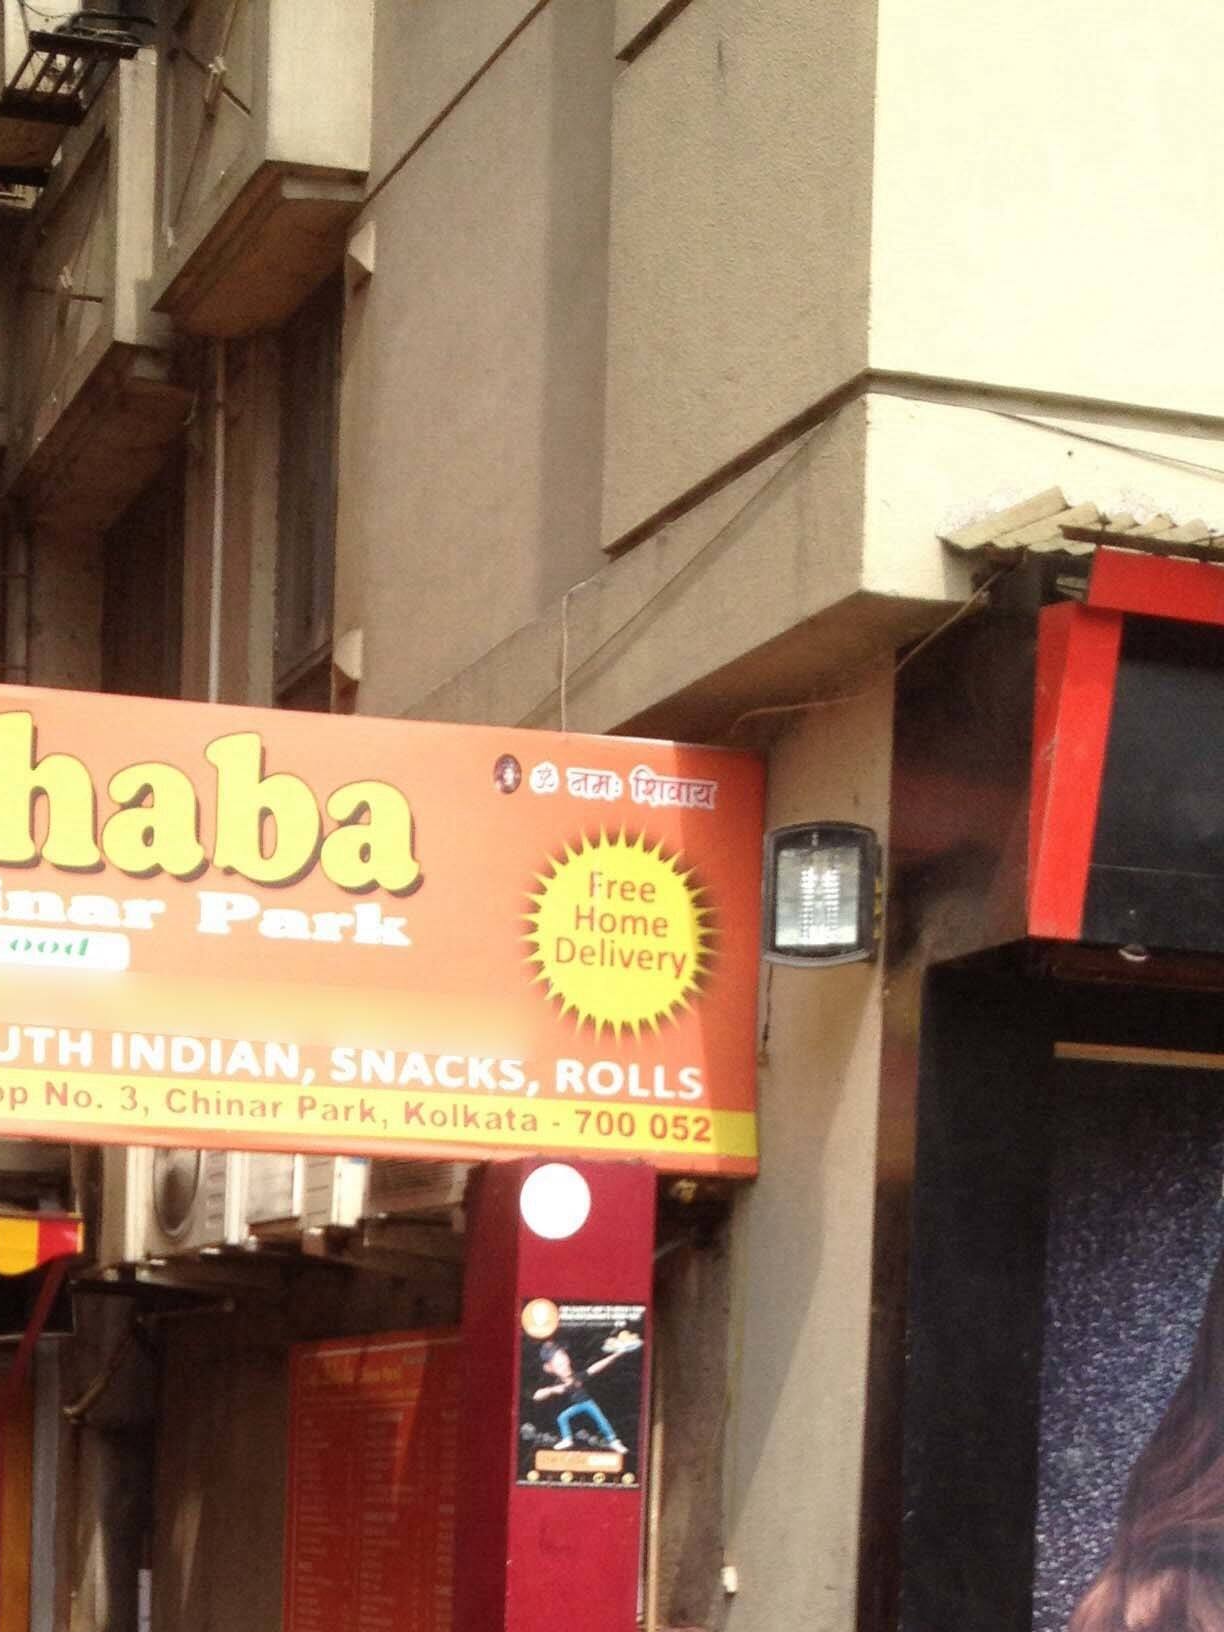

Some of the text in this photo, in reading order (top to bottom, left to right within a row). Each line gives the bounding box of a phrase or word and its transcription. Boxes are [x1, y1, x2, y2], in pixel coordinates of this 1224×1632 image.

[569, 769, 620, 797] नमः
[632, 767, 714, 807] शिवाय
[589, 871, 657, 904] Free
[197, 891, 412, 948] Park
[574, 904, 670, 938] Home
[555, 937, 687, 978] Delivery
[110, 1031, 316, 1086] INDIAN,
[329, 1046, 540, 1098] SNACKS,
[555, 1057, 704, 1100] ROLLS
[44, 1080, 104, 1109] No.
[120, 1085, 150, 1117] 3,
[164, 1087, 283, 1121] Chinar
[297, 1095, 389, 1130] Park,
[403, 1101, 539, 1133] Kolkata
[574, 1110, 636, 1138] 700
[649, 1112, 713, 1143] 052
